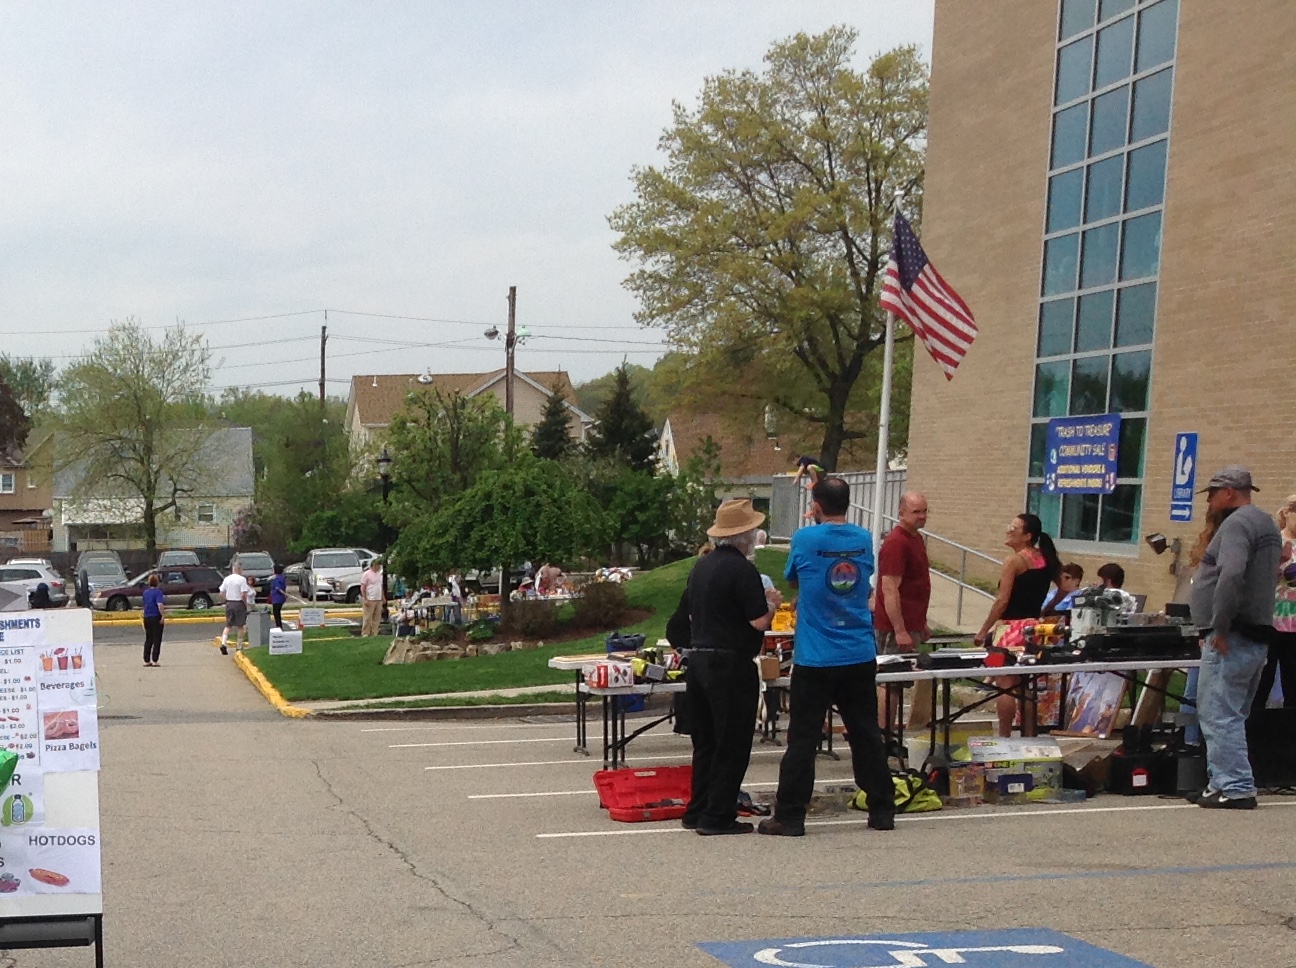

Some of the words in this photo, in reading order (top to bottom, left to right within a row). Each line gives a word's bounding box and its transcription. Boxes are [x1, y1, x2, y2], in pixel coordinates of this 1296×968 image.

[40, 681, 85, 691] Beverages
[45, 744, 67, 752] Pizza
[69, 741, 97, 752] Bagels
[29, 835, 96, 846] HOTDOGS
